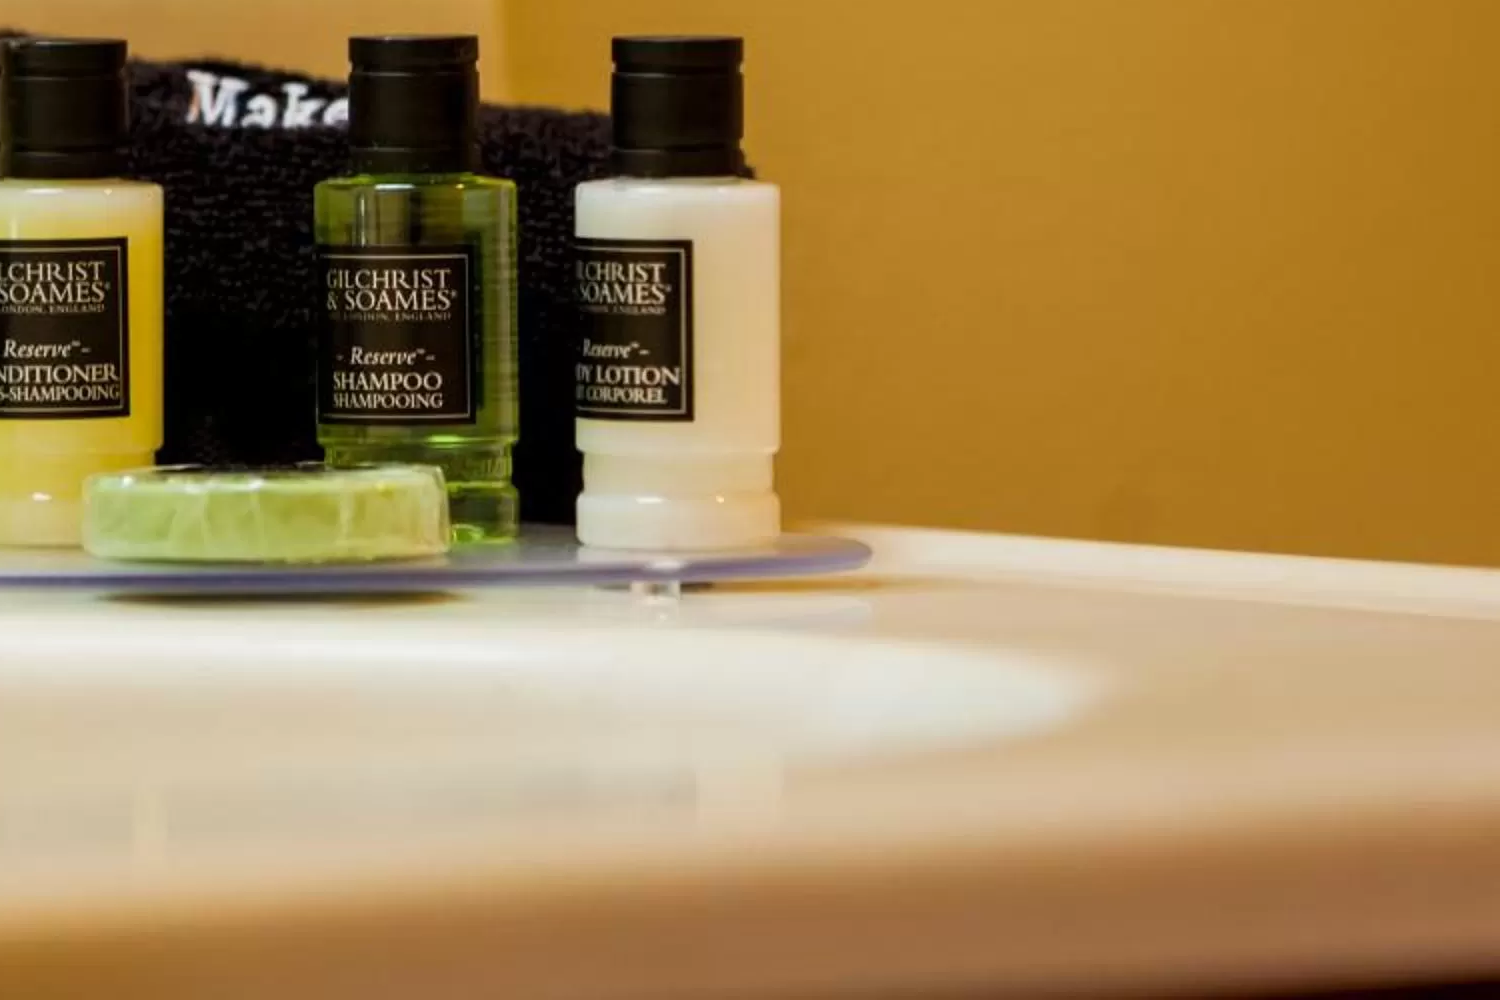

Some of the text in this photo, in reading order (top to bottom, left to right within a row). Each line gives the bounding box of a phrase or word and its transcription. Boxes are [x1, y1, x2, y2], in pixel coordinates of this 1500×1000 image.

[186, 69, 349, 129] Make
[326, 269, 451, 290] GILCHRIST
[327, 289, 451, 312] & SOAMES
[3, 339, 72, 359] Reserve
[350, 346, 417, 366] Reserve
[333, 372, 443, 392] SHAMPOO
[595, 365, 681, 386] LOTION
[333, 392, 443, 409] SHAMPOOING
